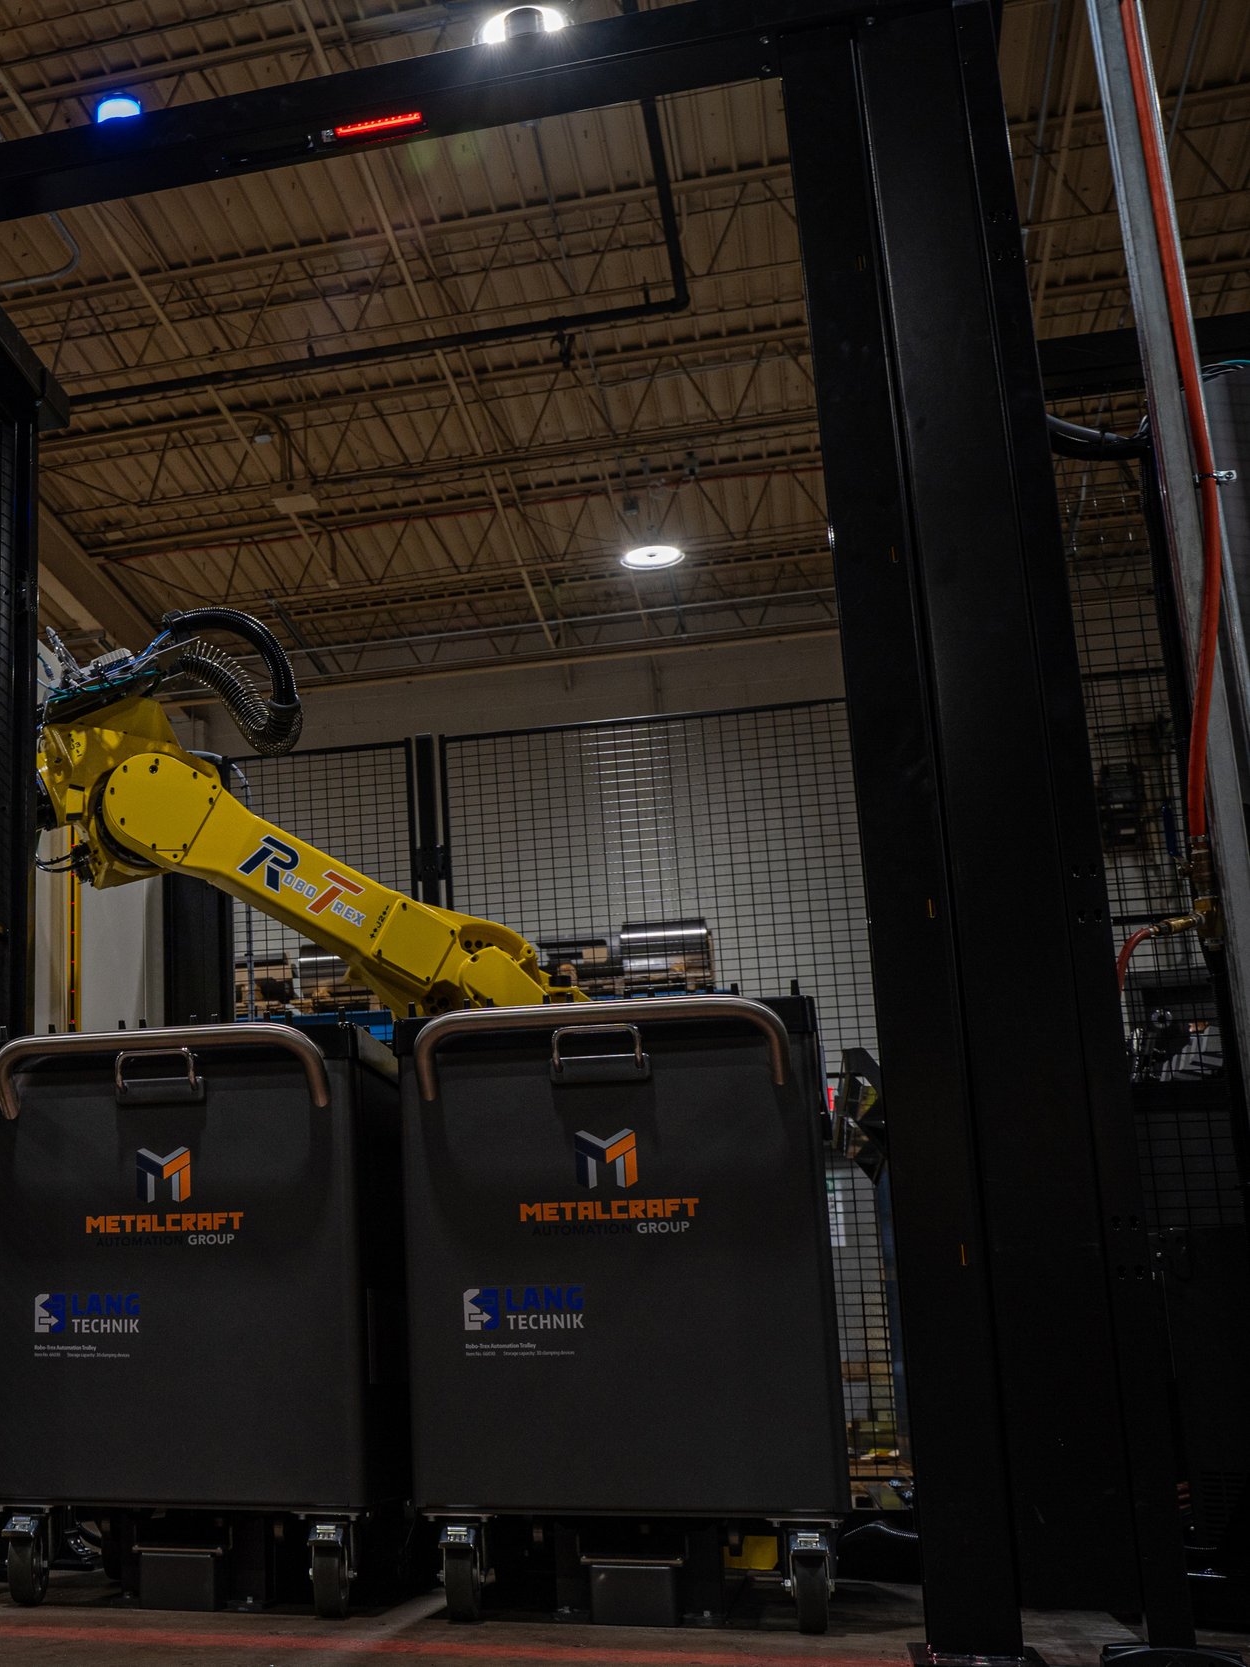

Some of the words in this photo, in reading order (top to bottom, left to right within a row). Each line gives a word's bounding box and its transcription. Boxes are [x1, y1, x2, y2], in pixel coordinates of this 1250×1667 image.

[519, 1198, 699, 1222] METALCRAFT
[85, 1211, 245, 1234] METALCRAFT
[532, 1222, 632, 1237] AUTOMATION
[636, 1220, 690, 1234] GROUP
[96, 1234, 183, 1248] AUTOMATION
[187, 1233, 235, 1246] GROUP
[71, 1293, 141, 1316] LANG
[505, 1286, 585, 1312] LANG
[71, 1318, 140, 1334] TECHNIK
[506, 1313, 585, 1330] TECHNIK
